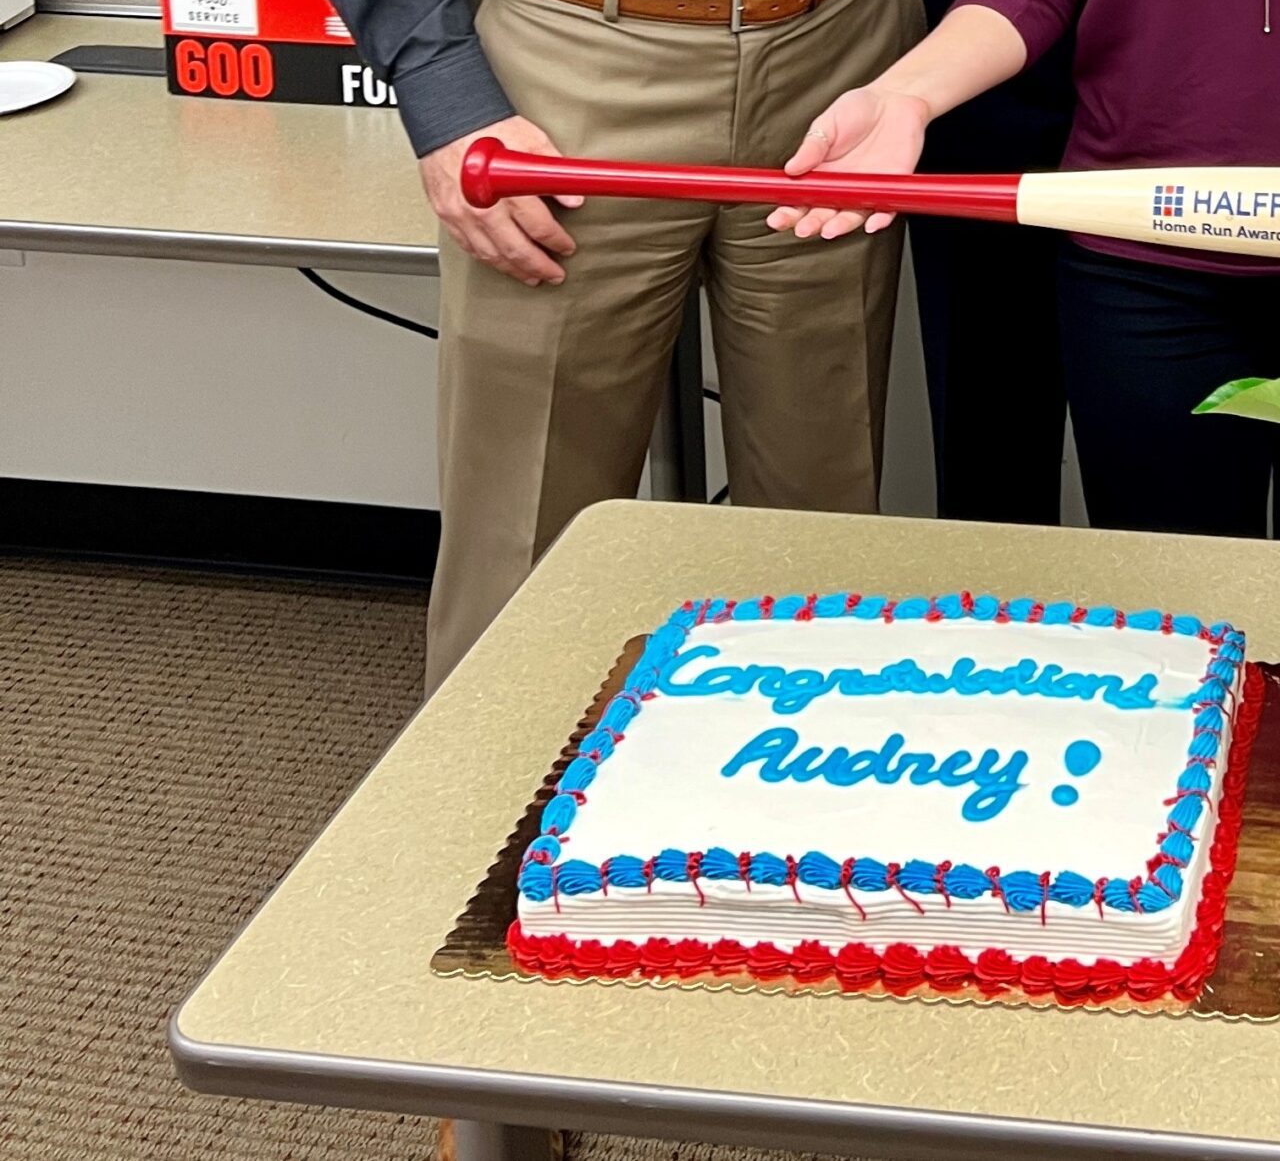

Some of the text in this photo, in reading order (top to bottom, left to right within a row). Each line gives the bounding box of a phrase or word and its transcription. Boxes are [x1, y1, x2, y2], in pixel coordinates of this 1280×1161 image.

[188, 11, 240, 24] SERVICE
[175, 40, 274, 98] 600
[1152, 220, 1197, 234] Home
[1201, 223, 1233, 238] Run
